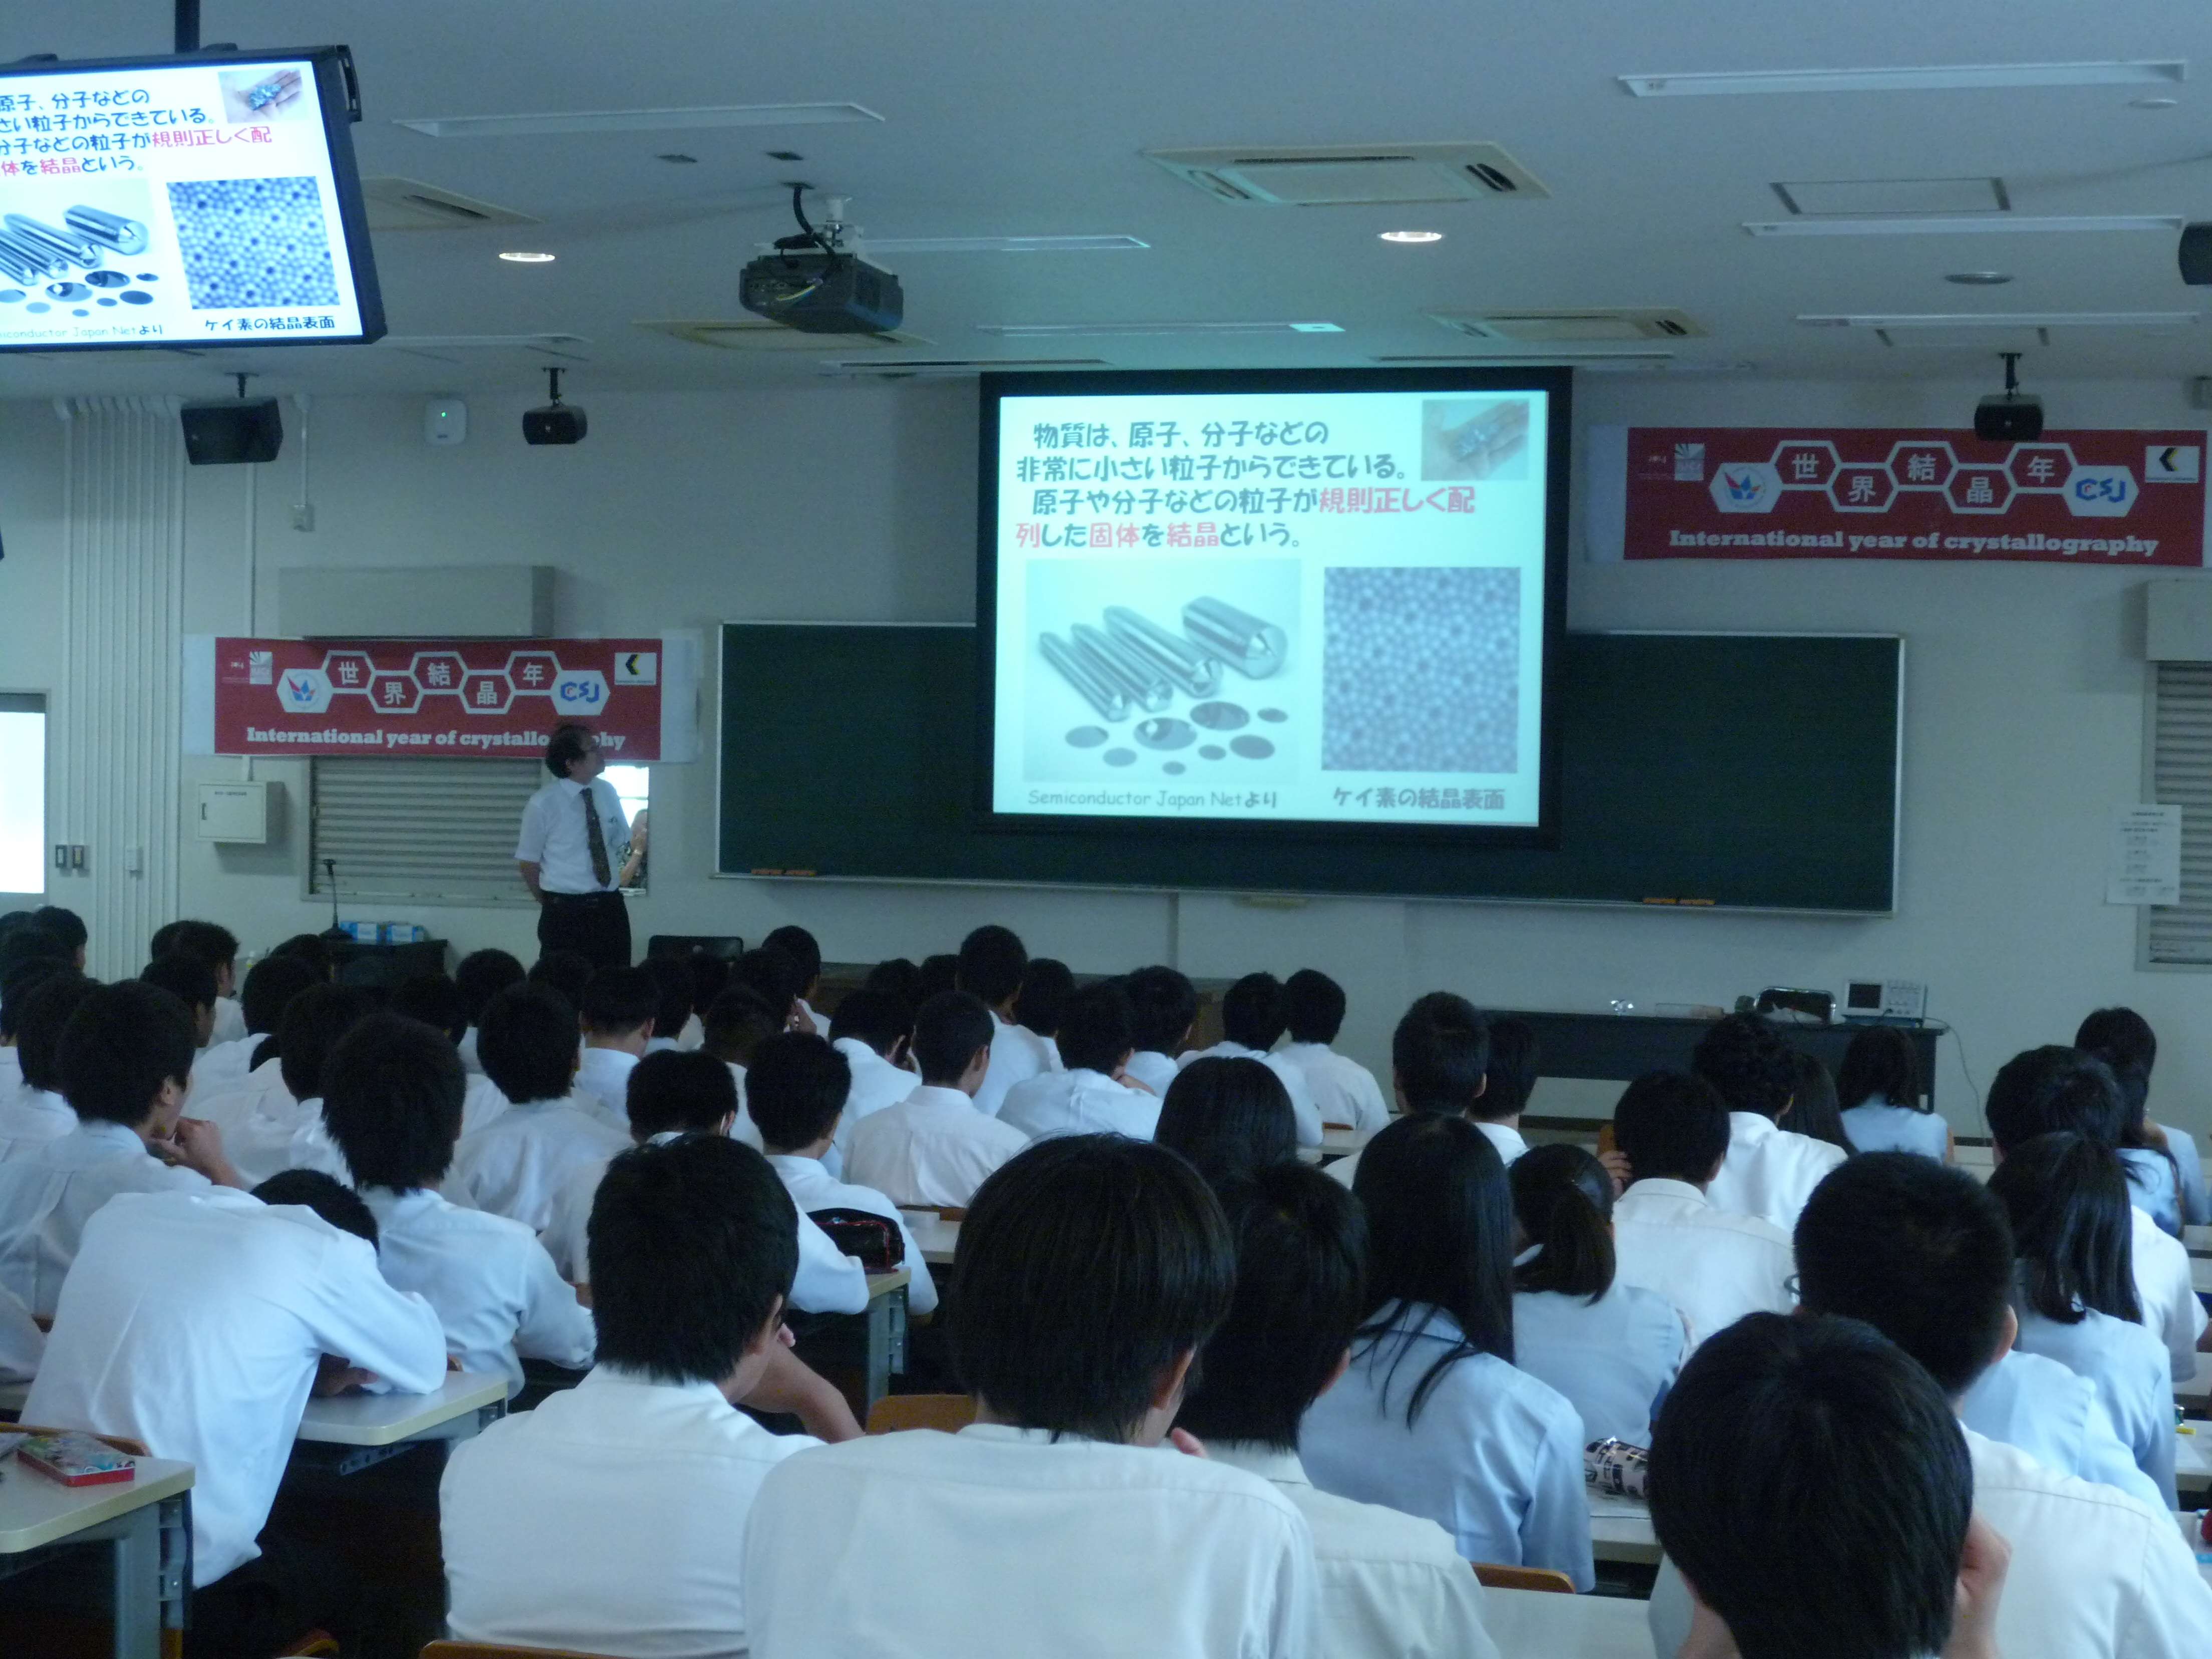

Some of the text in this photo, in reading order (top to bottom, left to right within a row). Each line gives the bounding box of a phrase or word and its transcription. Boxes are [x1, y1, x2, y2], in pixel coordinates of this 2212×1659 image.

[73, 327, 109, 339] Japan
[205, 316, 335, 331] ケイ素の結晶表面
[1033, 420, 1329, 449] 物質は、原子、分子などの
[1016, 454, 1405, 482] 非常に小さい粒子からできている。
[1033, 486, 1475, 515] 原子や分子などの粒子が規則正しく配
[2076, 478, 2126, 503] CSJ
[1015, 521, 1299, 547] 列した固体を結晶という。
[1669, 529, 2159, 557] International year of crystallography
[561, 681, 599, 703] CSJ
[247, 726, 626, 751] International year of crystallohy
[1028, 789, 1151, 806] Semiconductor
[1156, 790, 1205, 810] Japan
[1333, 787, 1506, 810] ケイ素の結晶表面
